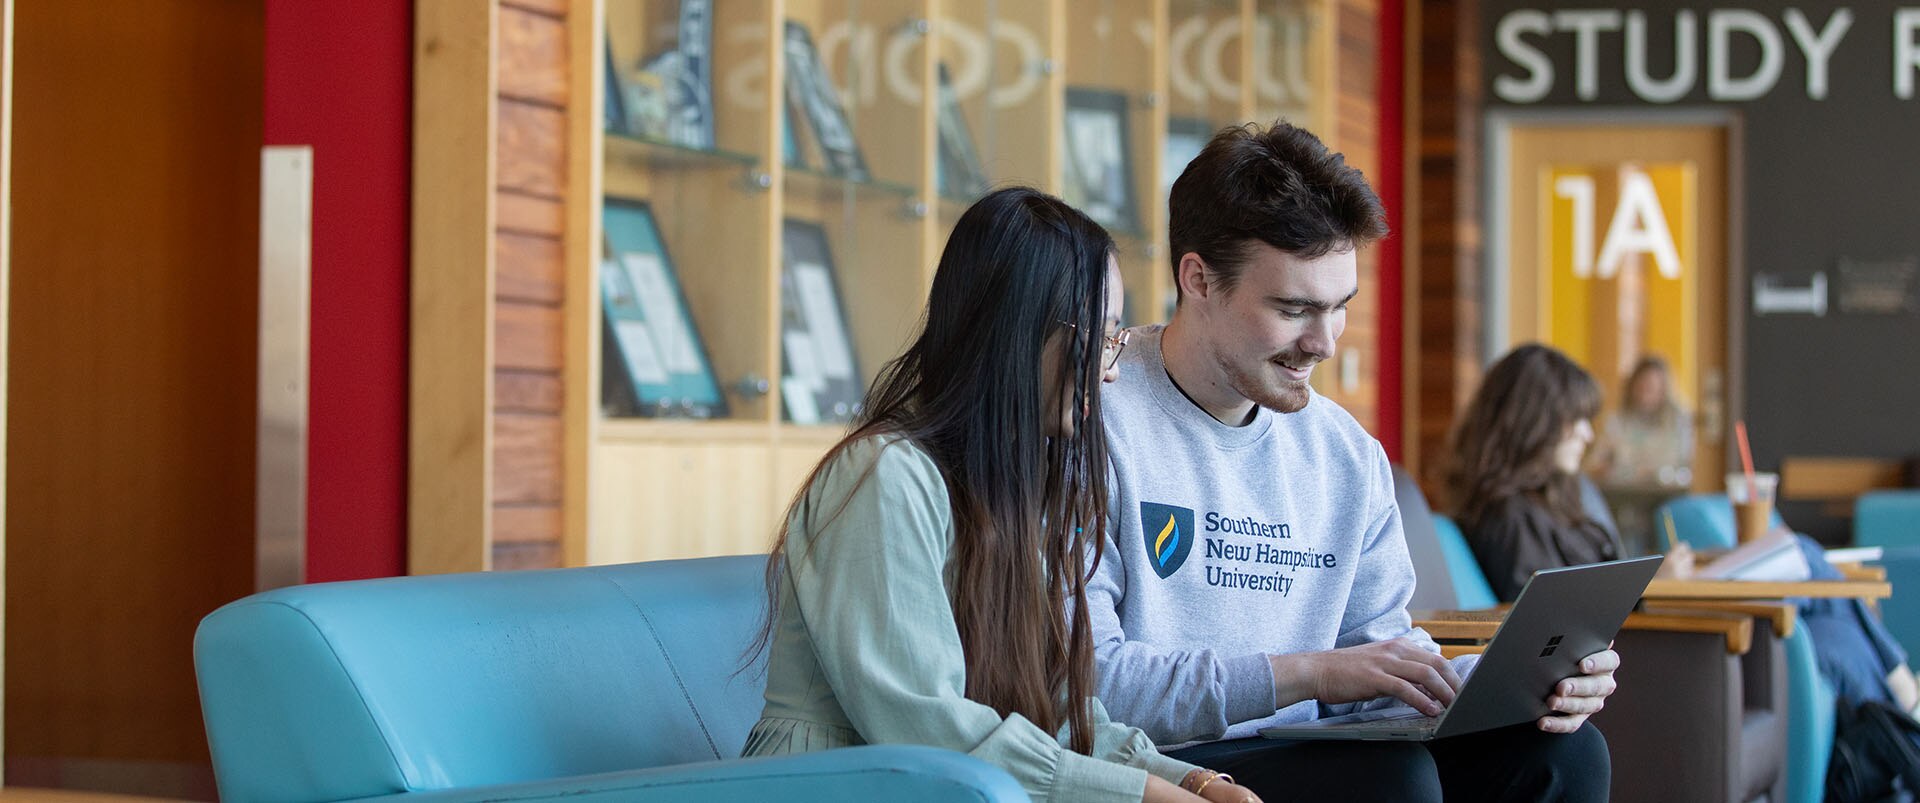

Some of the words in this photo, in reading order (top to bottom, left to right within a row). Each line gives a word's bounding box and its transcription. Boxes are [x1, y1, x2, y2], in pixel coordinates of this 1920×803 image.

[1495, 8, 1853, 101] STUDY
[1555, 171, 1682, 280] 1A
[1205, 511, 1292, 539] Southern
[1205, 538, 1251, 561] New
[1255, 543, 1337, 572] Hampshire
[1205, 565, 1294, 598] University
